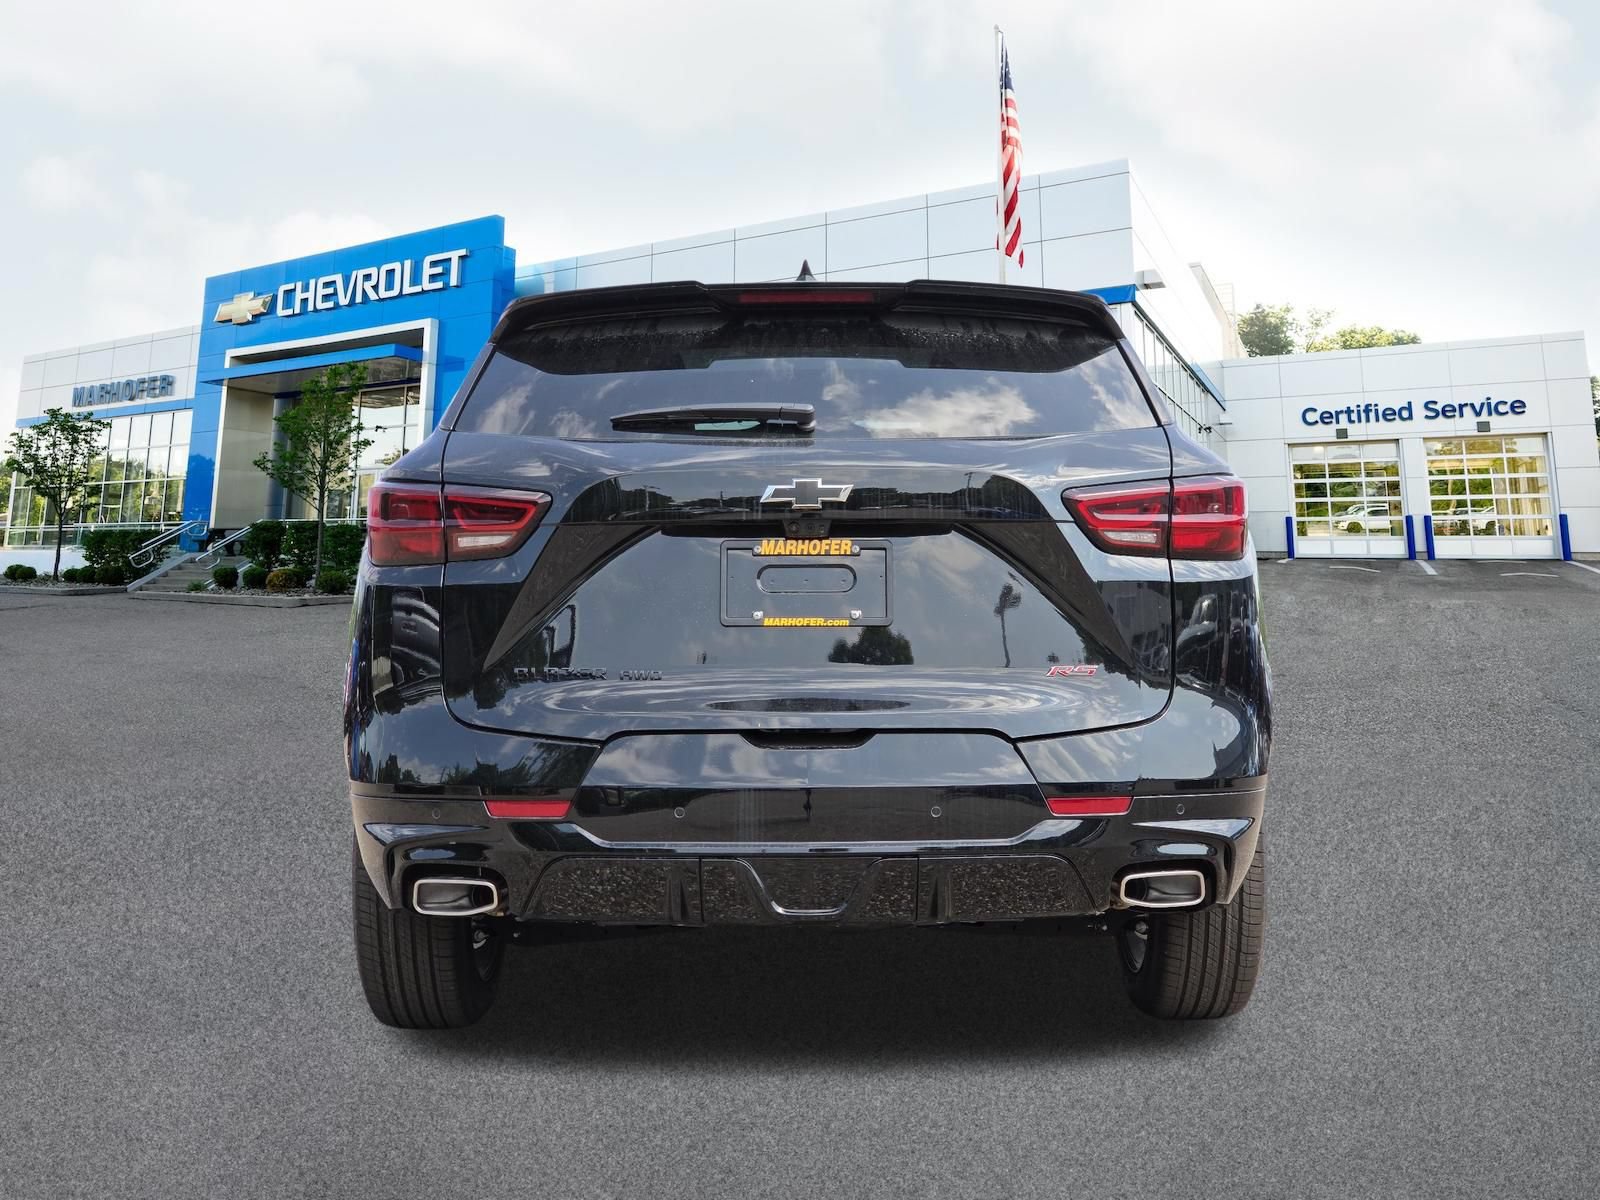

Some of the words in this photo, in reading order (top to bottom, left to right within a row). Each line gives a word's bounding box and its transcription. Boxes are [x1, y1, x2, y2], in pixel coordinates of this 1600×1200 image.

[277, 248, 469, 317] CHEVROLET
[72, 374, 176, 407] MARHOFER
[1301, 401, 1413, 426] Certified
[1424, 397, 1527, 420] Service
[761, 539, 853, 555] MARHOFER
[763, 617, 849, 626] MARHOFER.com
[619, 670, 663, 681] AWD
[1046, 665, 1099, 677] RS
